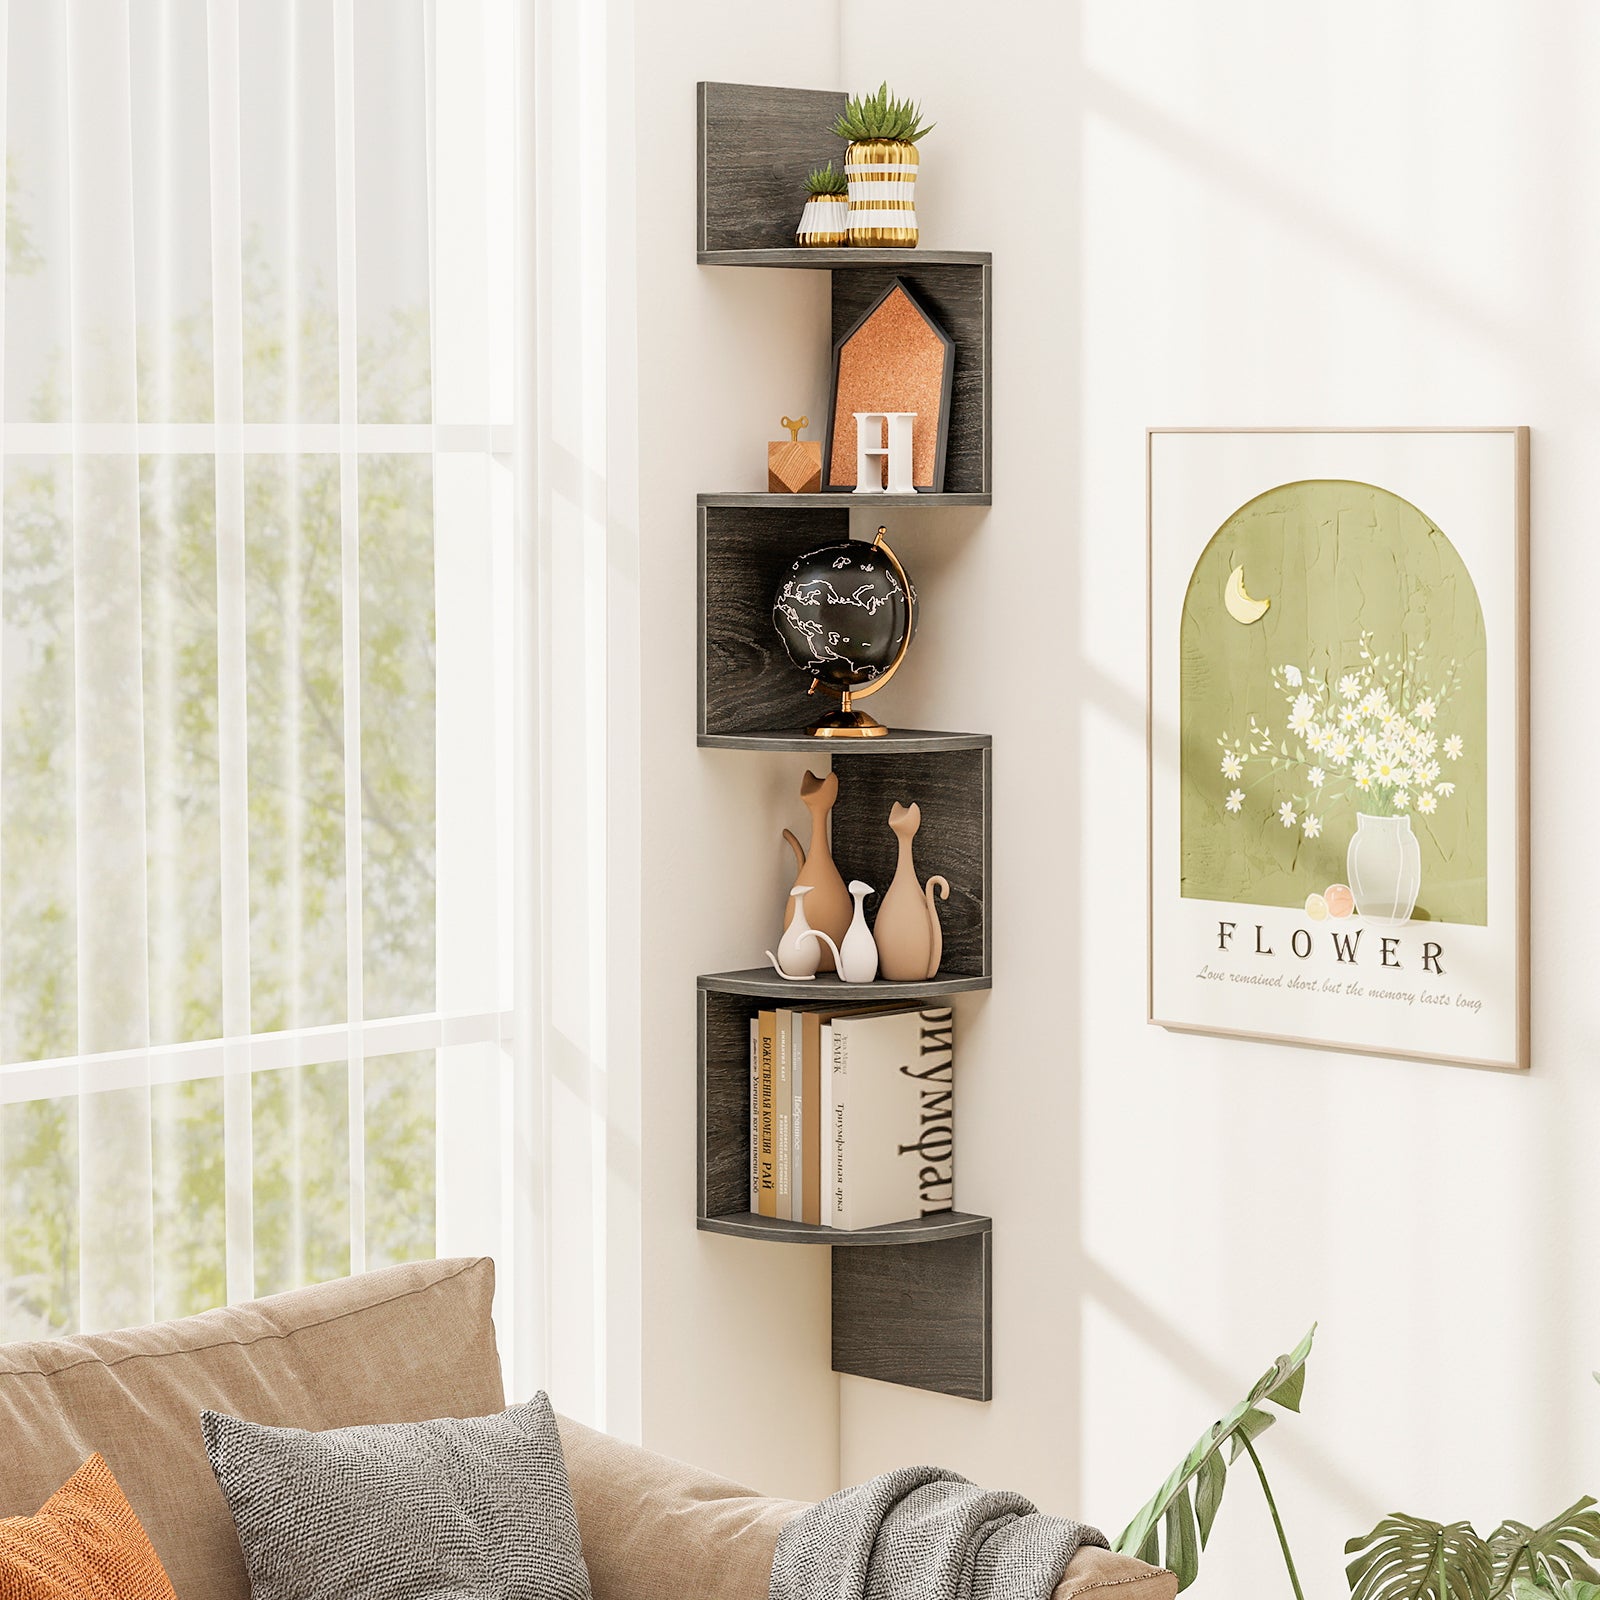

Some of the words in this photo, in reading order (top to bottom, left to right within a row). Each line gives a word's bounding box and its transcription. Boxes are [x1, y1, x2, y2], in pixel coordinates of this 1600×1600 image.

[1217, 921, 1448, 976] FLOWER
[1196, 965, 1225, 981] Love
[1229, 974, 1284, 988] remained
[1345, 981, 1364, 997] the
[1368, 989, 1416, 1006] memory
[1420, 990, 1451, 1006] lasts
[1455, 994, 1482, 1014] long
[763, 1037, 771, 1108] БОЖЕСТВЕННАЯ
[762, 1111, 771, 1154] КОМЕДИЯ
[762, 1162, 774, 1189] РАЙ
